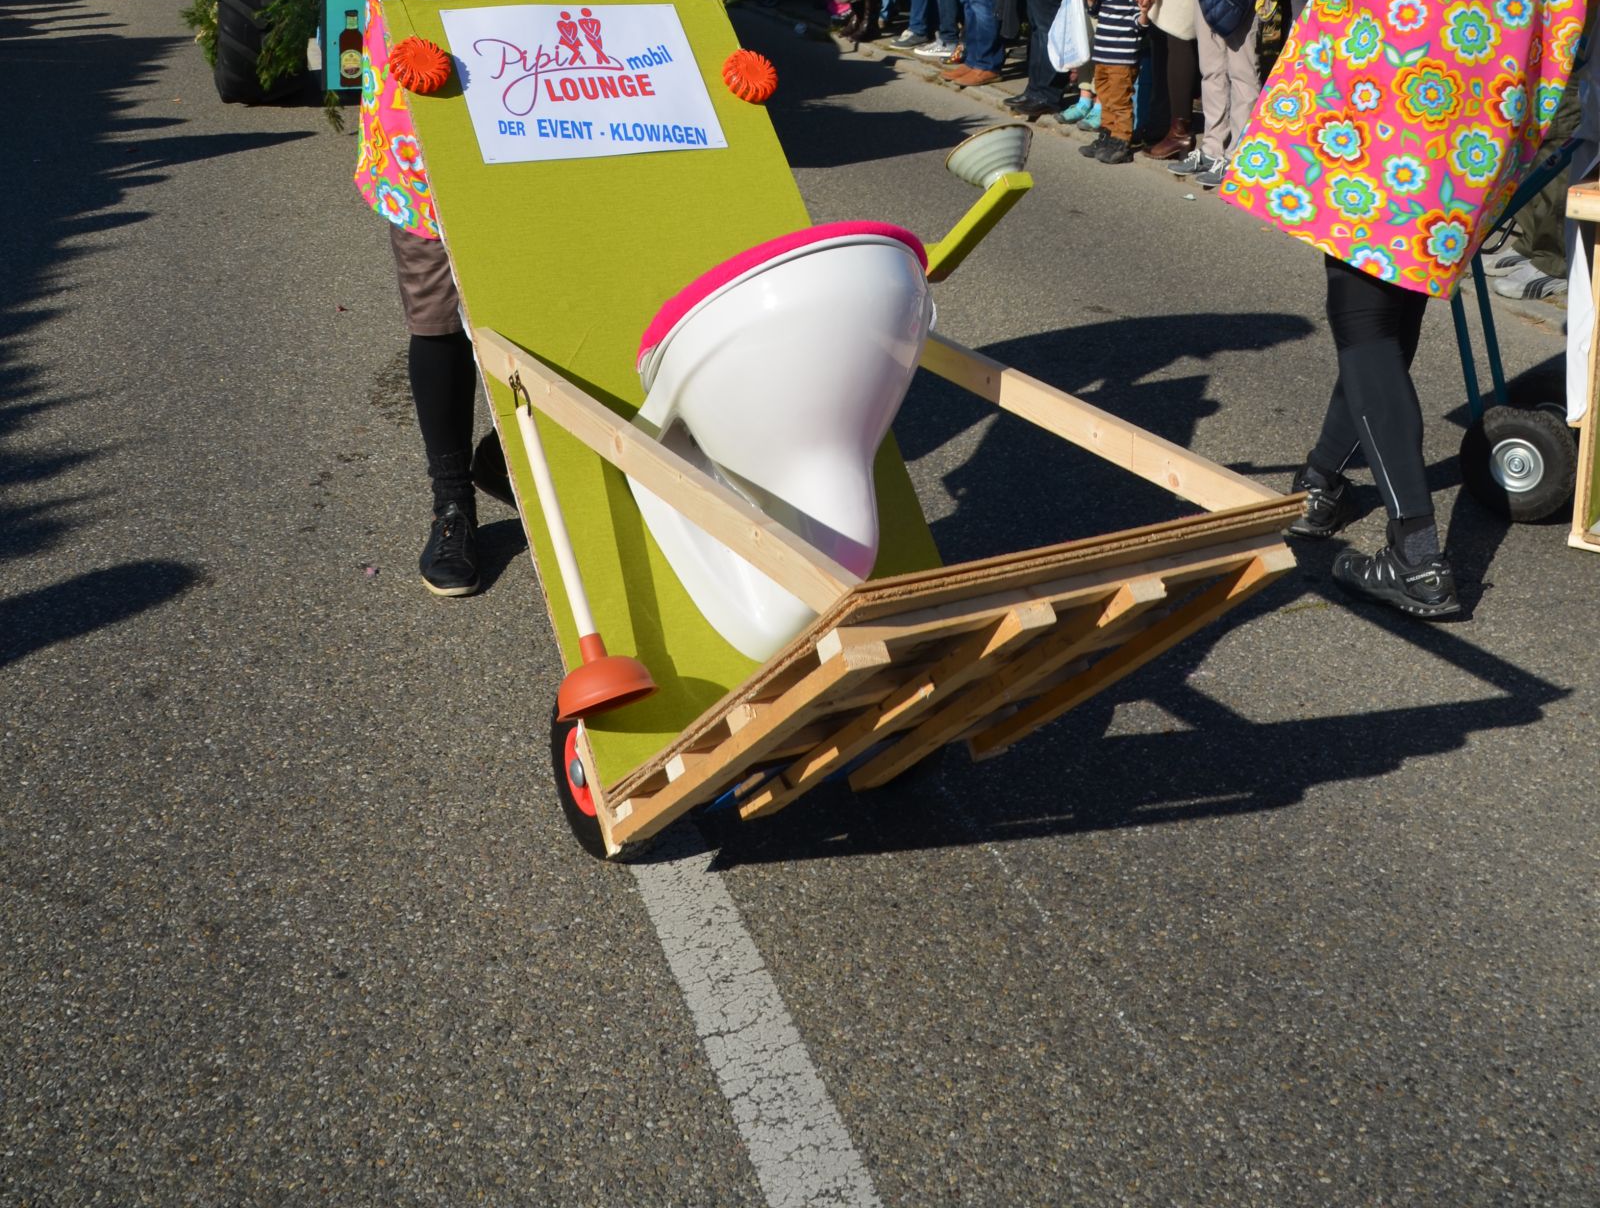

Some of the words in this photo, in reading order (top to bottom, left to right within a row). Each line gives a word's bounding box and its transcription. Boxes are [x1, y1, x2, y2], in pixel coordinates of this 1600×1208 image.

[626, 44, 673, 70] mobil
[544, 73, 656, 102] LOUNGE
[498, 120, 526, 136] DER
[537, 118, 593, 140] EVENT
[609, 123, 708, 145] KLOWAGEN
